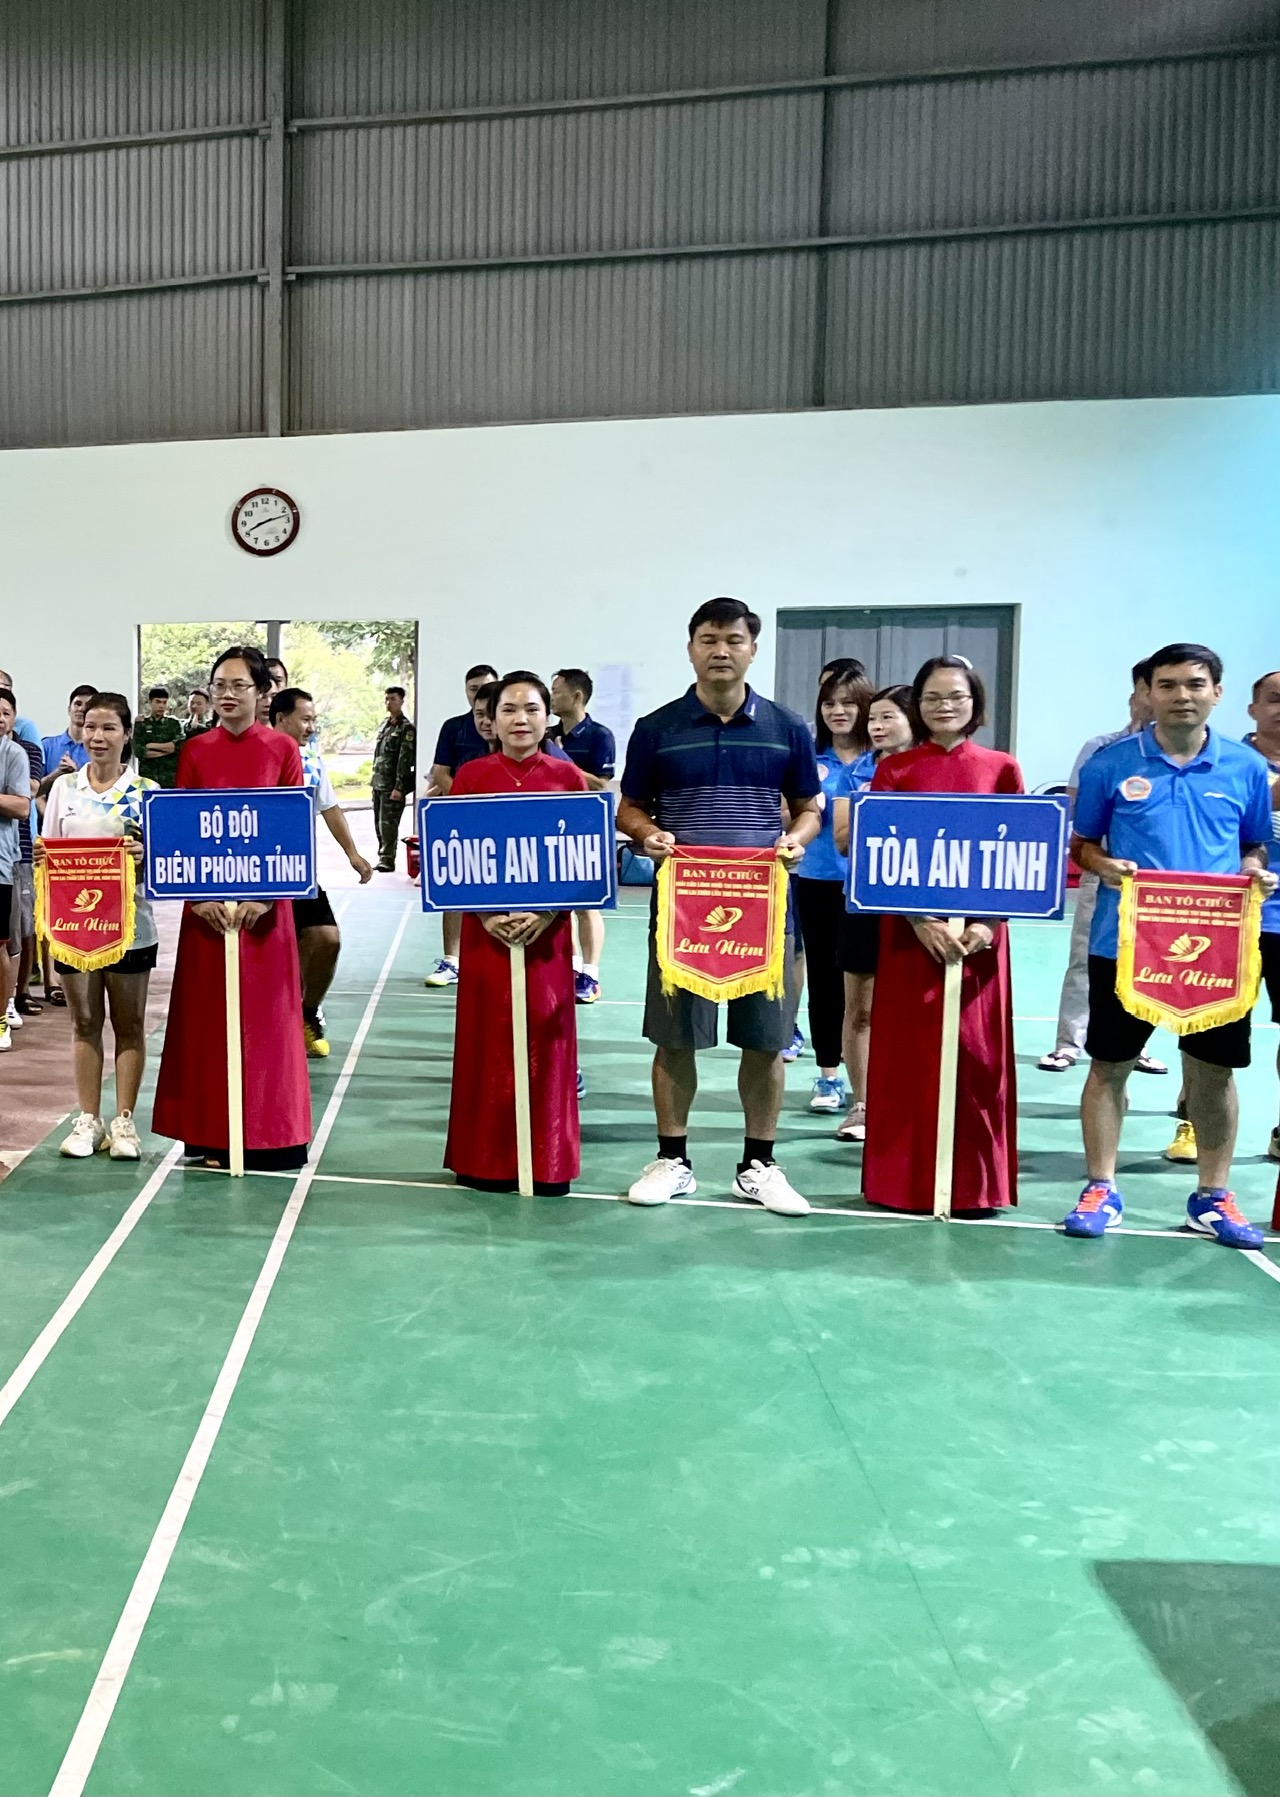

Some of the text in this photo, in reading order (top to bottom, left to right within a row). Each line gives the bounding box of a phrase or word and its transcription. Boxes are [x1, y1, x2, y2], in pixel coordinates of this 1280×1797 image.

[200, 804, 258, 844] BỘ ĐỘI
[53, 858, 72, 866] BAN
[155, 844, 306, 884] BIÊN PHÒNG TỈNH
[431, 819, 602, 886] CÔNG AN TỈNH
[866, 824, 1048, 891] TÒA ÁN TỈNH
[683, 869, 706, 878] BAN
[1145, 894, 1173, 904] BAN
[674, 938, 764, 959] Lưu Niệm
[1134, 966, 1233, 990] Lưu Niệm
